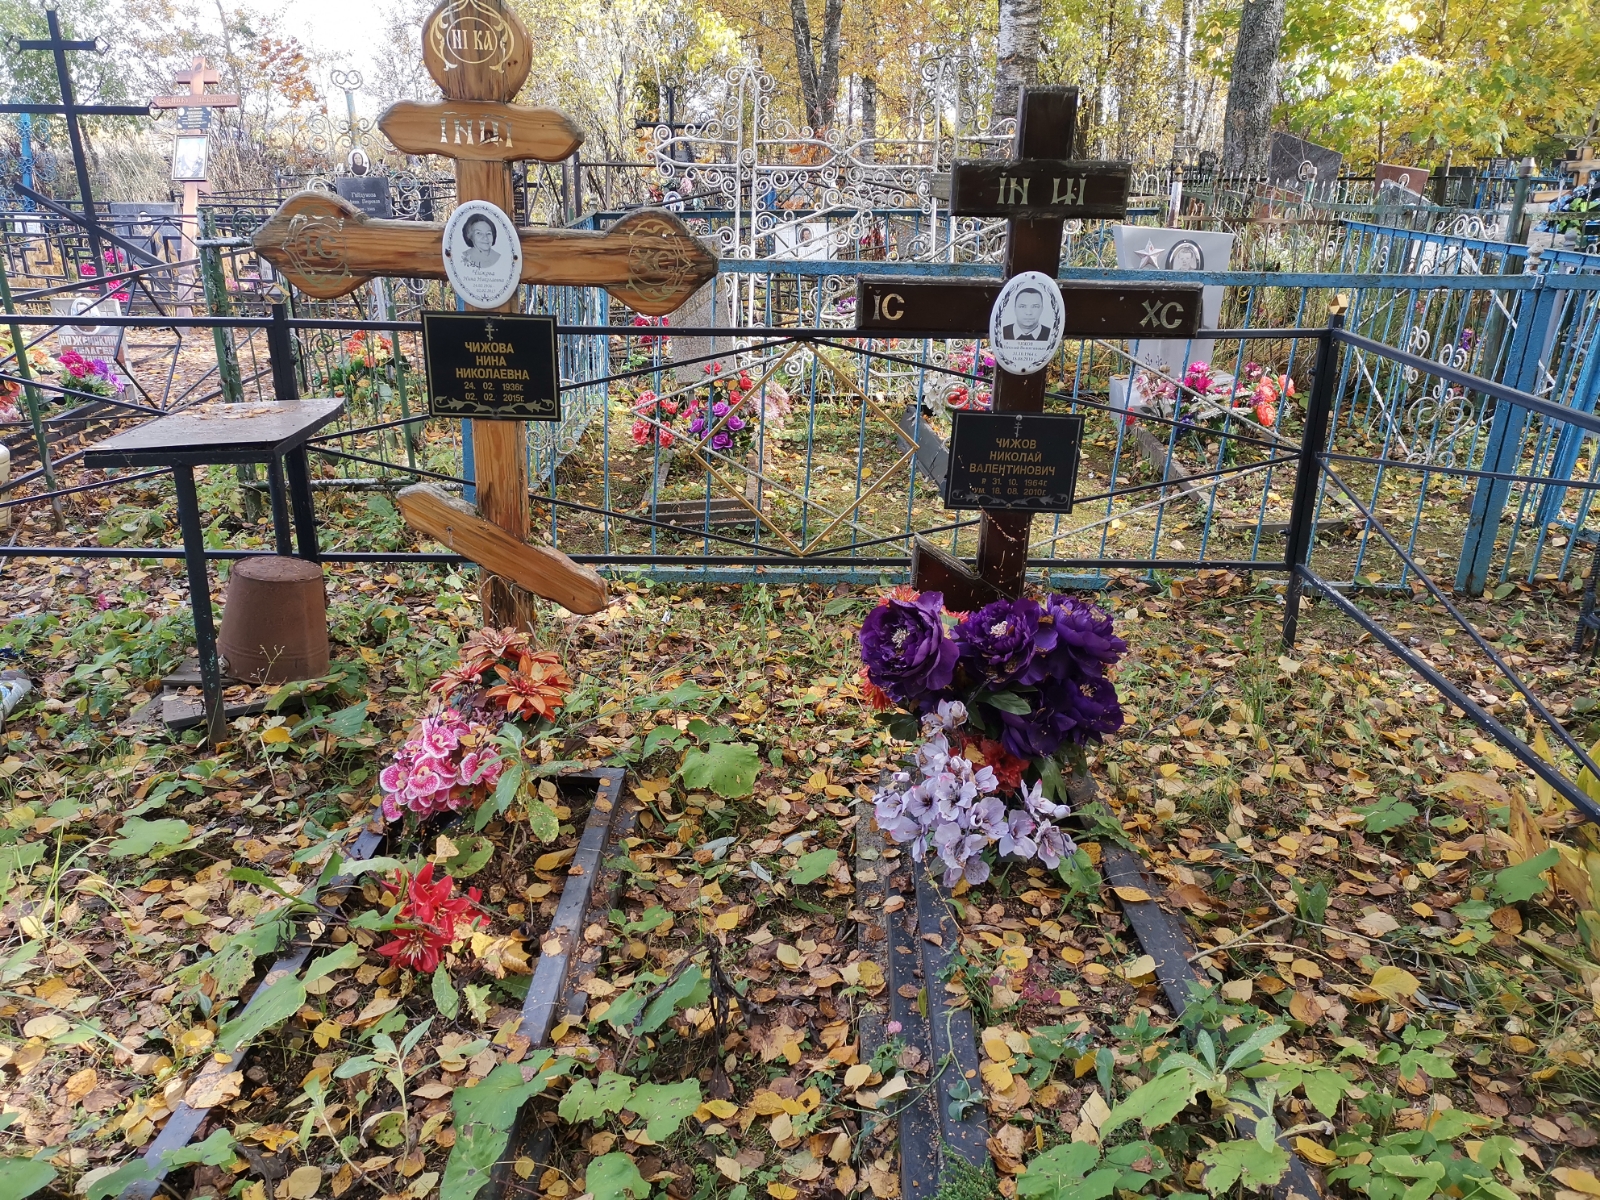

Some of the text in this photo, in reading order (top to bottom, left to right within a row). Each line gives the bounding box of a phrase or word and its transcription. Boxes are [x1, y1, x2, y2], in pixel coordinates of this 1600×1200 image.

[464, 341, 515, 354] ЧИЖОВА
[475, 355, 507, 367] НИНА
[455, 367, 530, 380] НИКОЛАЕВНА
[463, 381, 476, 390] 24.
[482, 381, 495, 390] 02.
[464, 392, 478, 401] 02.
[483, 393, 496, 402] 02.
[995, 437, 1038, 449] ЧИЖОВ
[989, 450, 1043, 463] НИКОЛАЙ
[969, 463, 1057, 476] ВАЛЕНТИНОВИЧ
[992, 477, 1002, 485] 31.
[1008, 478, 1018, 486] 10.
[992, 487, 1002, 495] 18.
[1007, 487, 1019, 495] 08.
